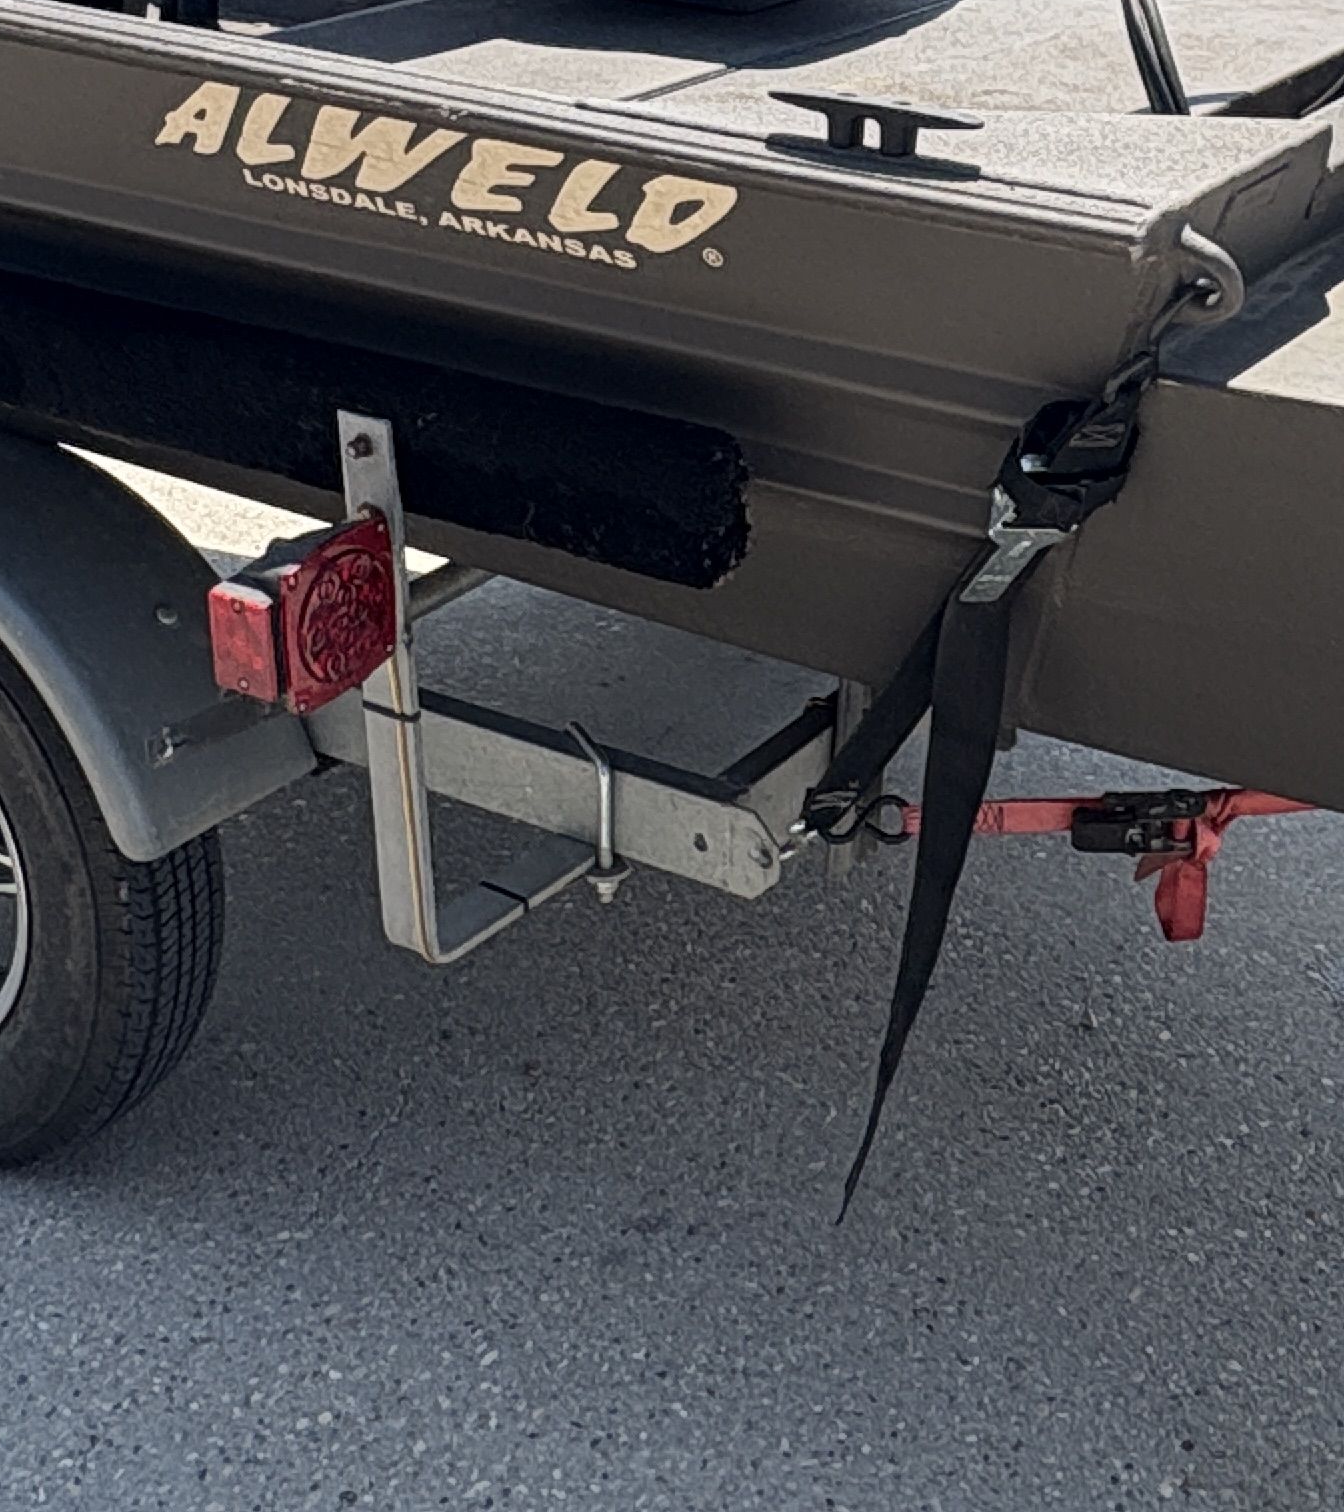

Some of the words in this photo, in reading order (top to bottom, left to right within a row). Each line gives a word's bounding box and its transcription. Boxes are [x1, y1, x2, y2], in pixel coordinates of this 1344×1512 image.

[155, 81, 738, 254] ALWELD
[243, 168, 428, 227] LONSDALE,
[438, 210, 638, 271] ARKANSAS
